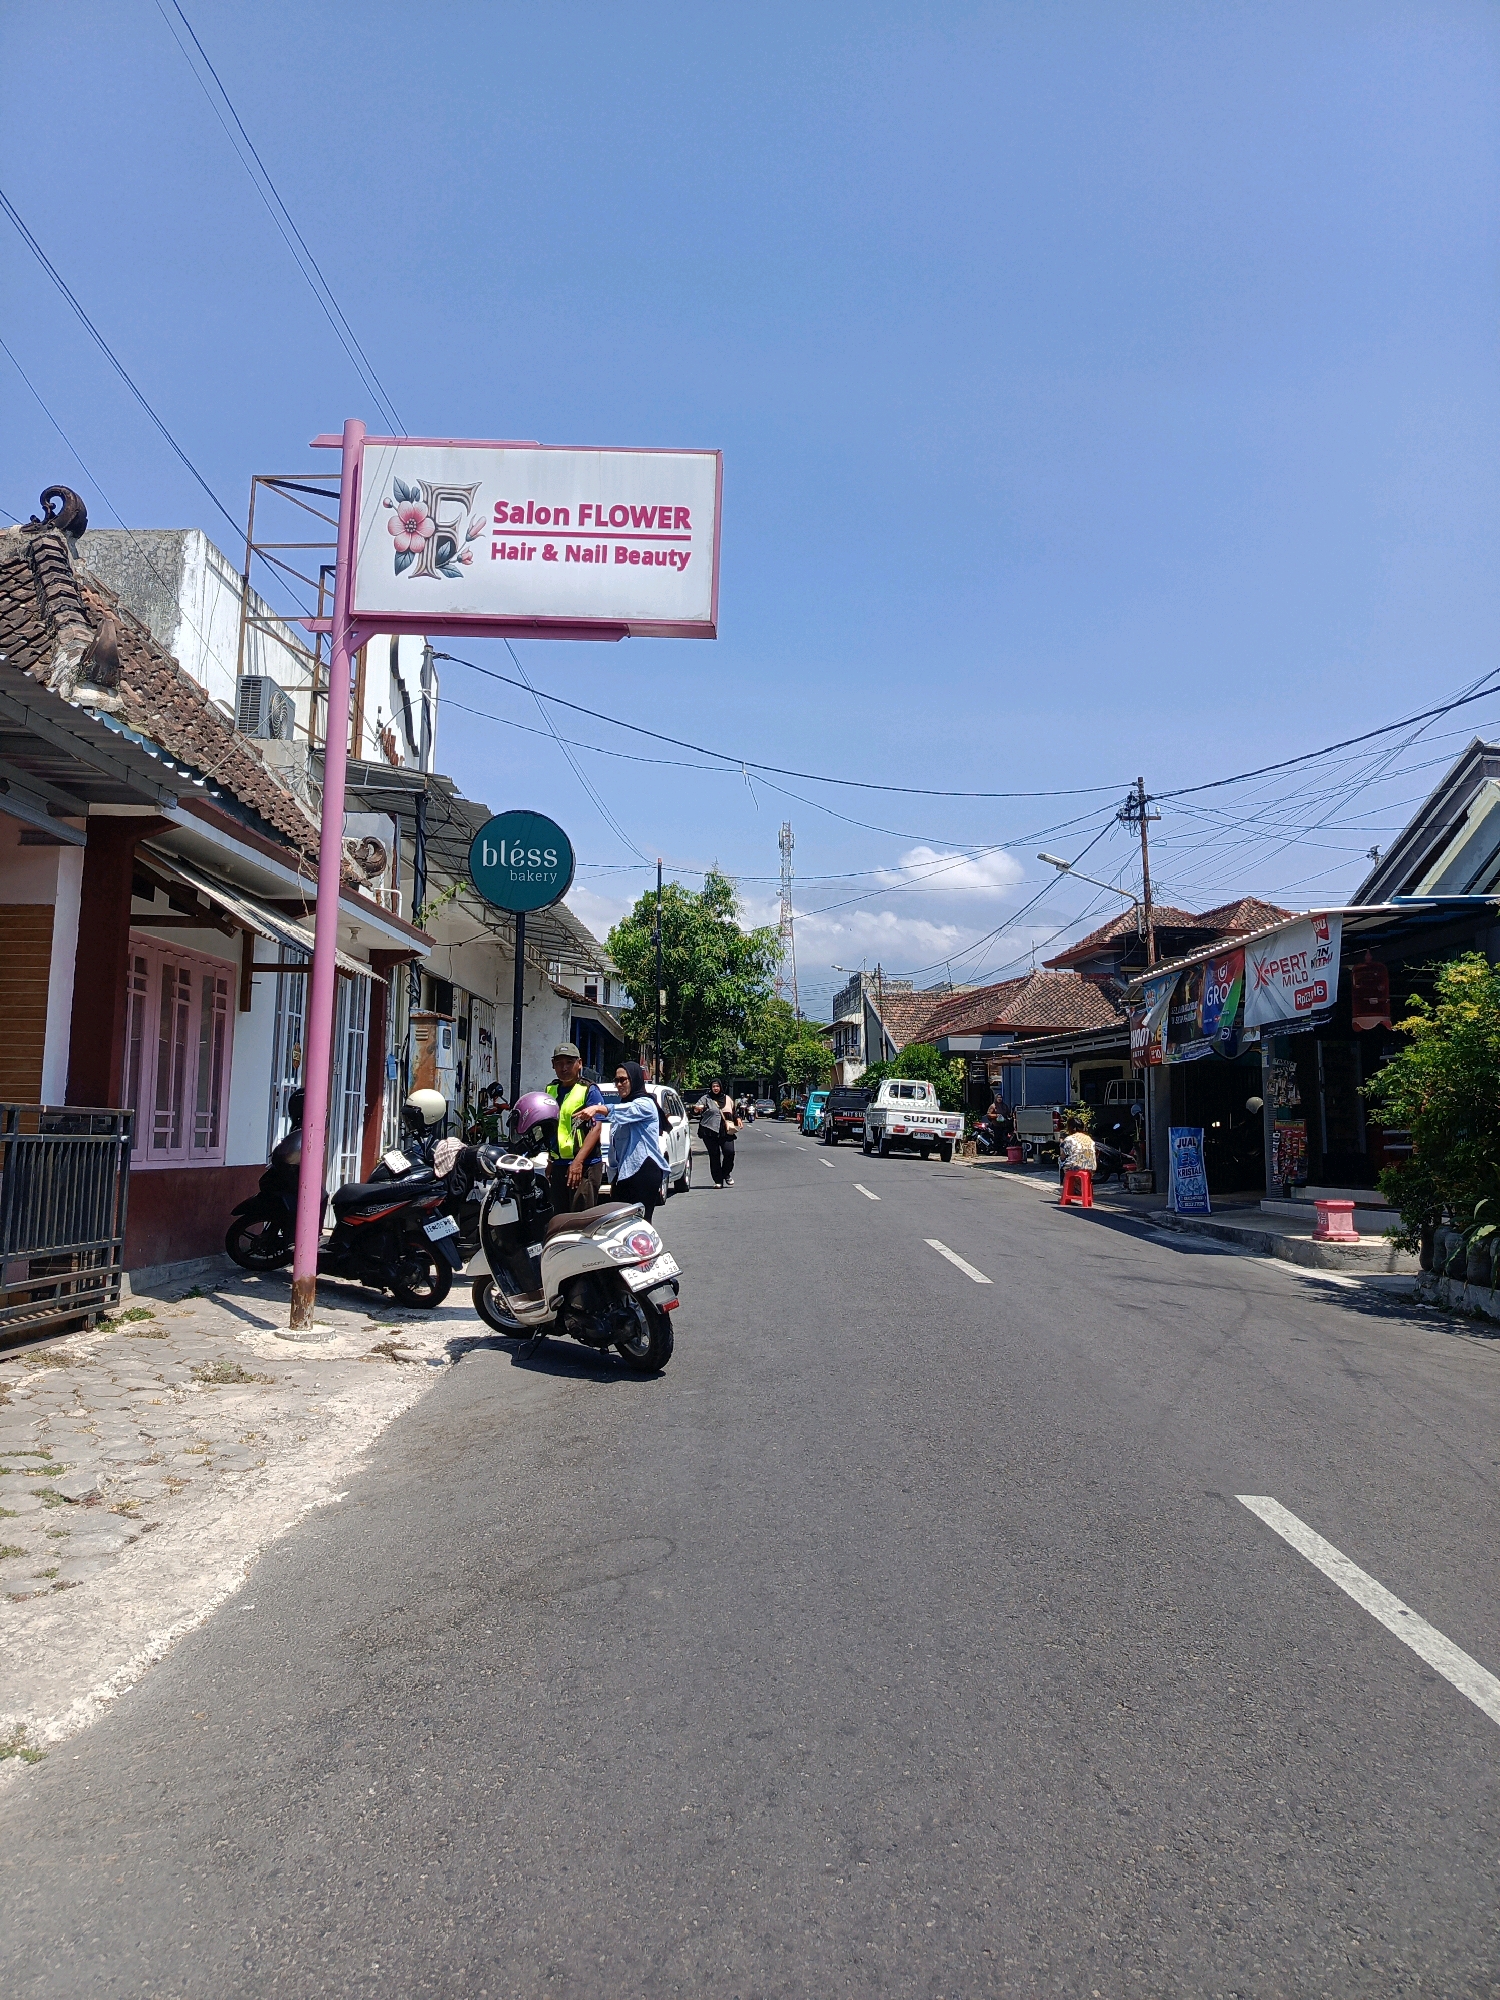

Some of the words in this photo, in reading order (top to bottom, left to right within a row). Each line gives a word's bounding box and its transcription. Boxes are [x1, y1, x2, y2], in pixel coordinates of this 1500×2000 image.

[493, 500, 570, 525] Salon
[578, 504, 692, 530] FLOWER
[491, 542, 537, 561] Hair
[542, 543, 558, 562] &
[565, 544, 607, 564] Nail
[614, 546, 692, 571] Beauty
[482, 839, 558, 868] bléss
[510, 870, 558, 884] bakery
[1282, 971, 1308, 988] MILD
[903, 1115, 948, 1125] SUZUKI
[1177, 1137, 1197, 1148] JUAL
[1177, 1148, 1199, 1168] ES
[1177, 1167, 1202, 1178] KRISTAL
